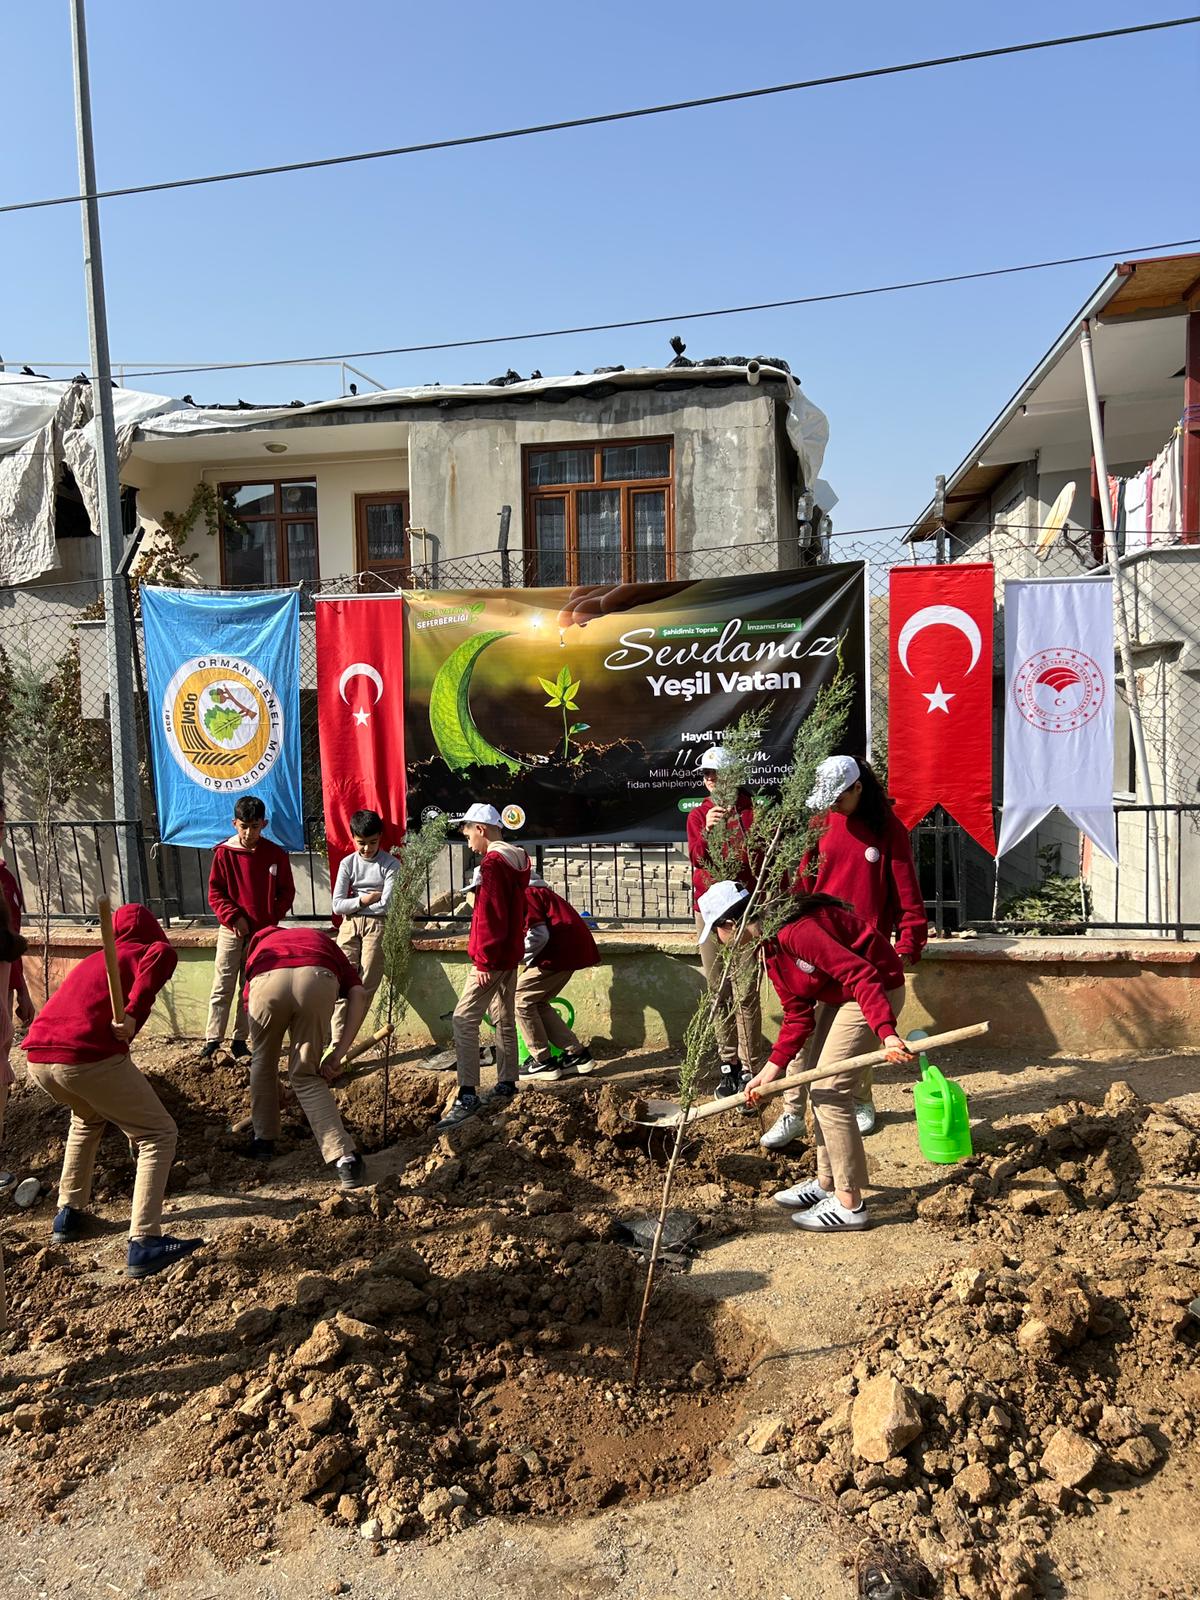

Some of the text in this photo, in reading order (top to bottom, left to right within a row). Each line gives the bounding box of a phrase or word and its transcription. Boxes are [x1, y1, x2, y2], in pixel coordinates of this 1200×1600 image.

[662, 628, 695, 637] Şahidimiz
[695, 626, 719, 635] Toprak
[747, 623, 775, 631] İmzamız
[604, 618, 839, 670] Sevdamız
[646, 670, 801, 702] Yeşil Vatan
[181, 692, 198, 725] OGM
[198, 659, 280, 791] ORMAN GENEL MÜDÜRLÜĞÜ
[681, 730, 713, 743] Haydi
[674, 749, 693, 766] 11
[649, 769, 669, 778] Milli
[627, 781, 651, 789] fidan
